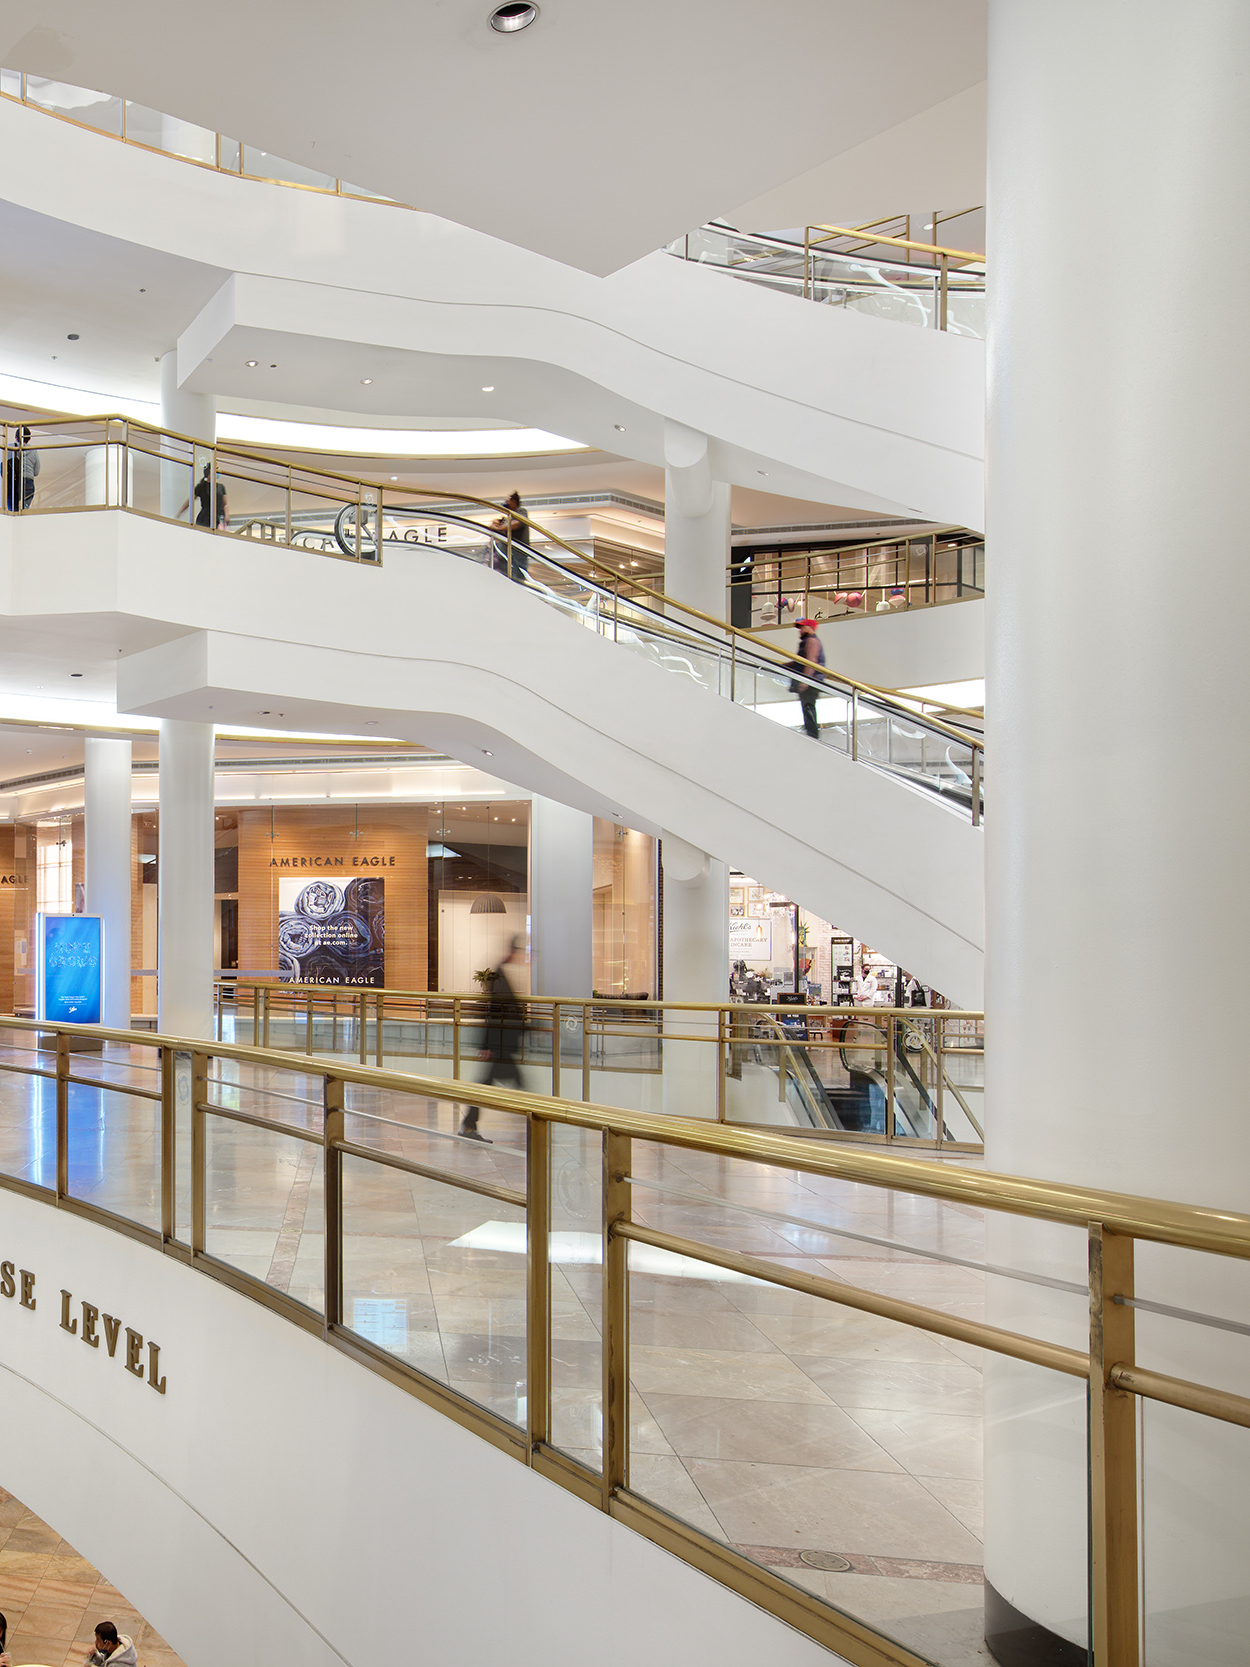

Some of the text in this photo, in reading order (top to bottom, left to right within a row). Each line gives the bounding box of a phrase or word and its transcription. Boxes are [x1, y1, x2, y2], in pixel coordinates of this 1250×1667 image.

[388, 527, 448, 543] AGLE
[270, 856, 396, 867] AMERICAN EAGLE
[288, 976, 375, 984] AMERICAN EAGLE
[59, 1289, 166, 1394] LEVEL
